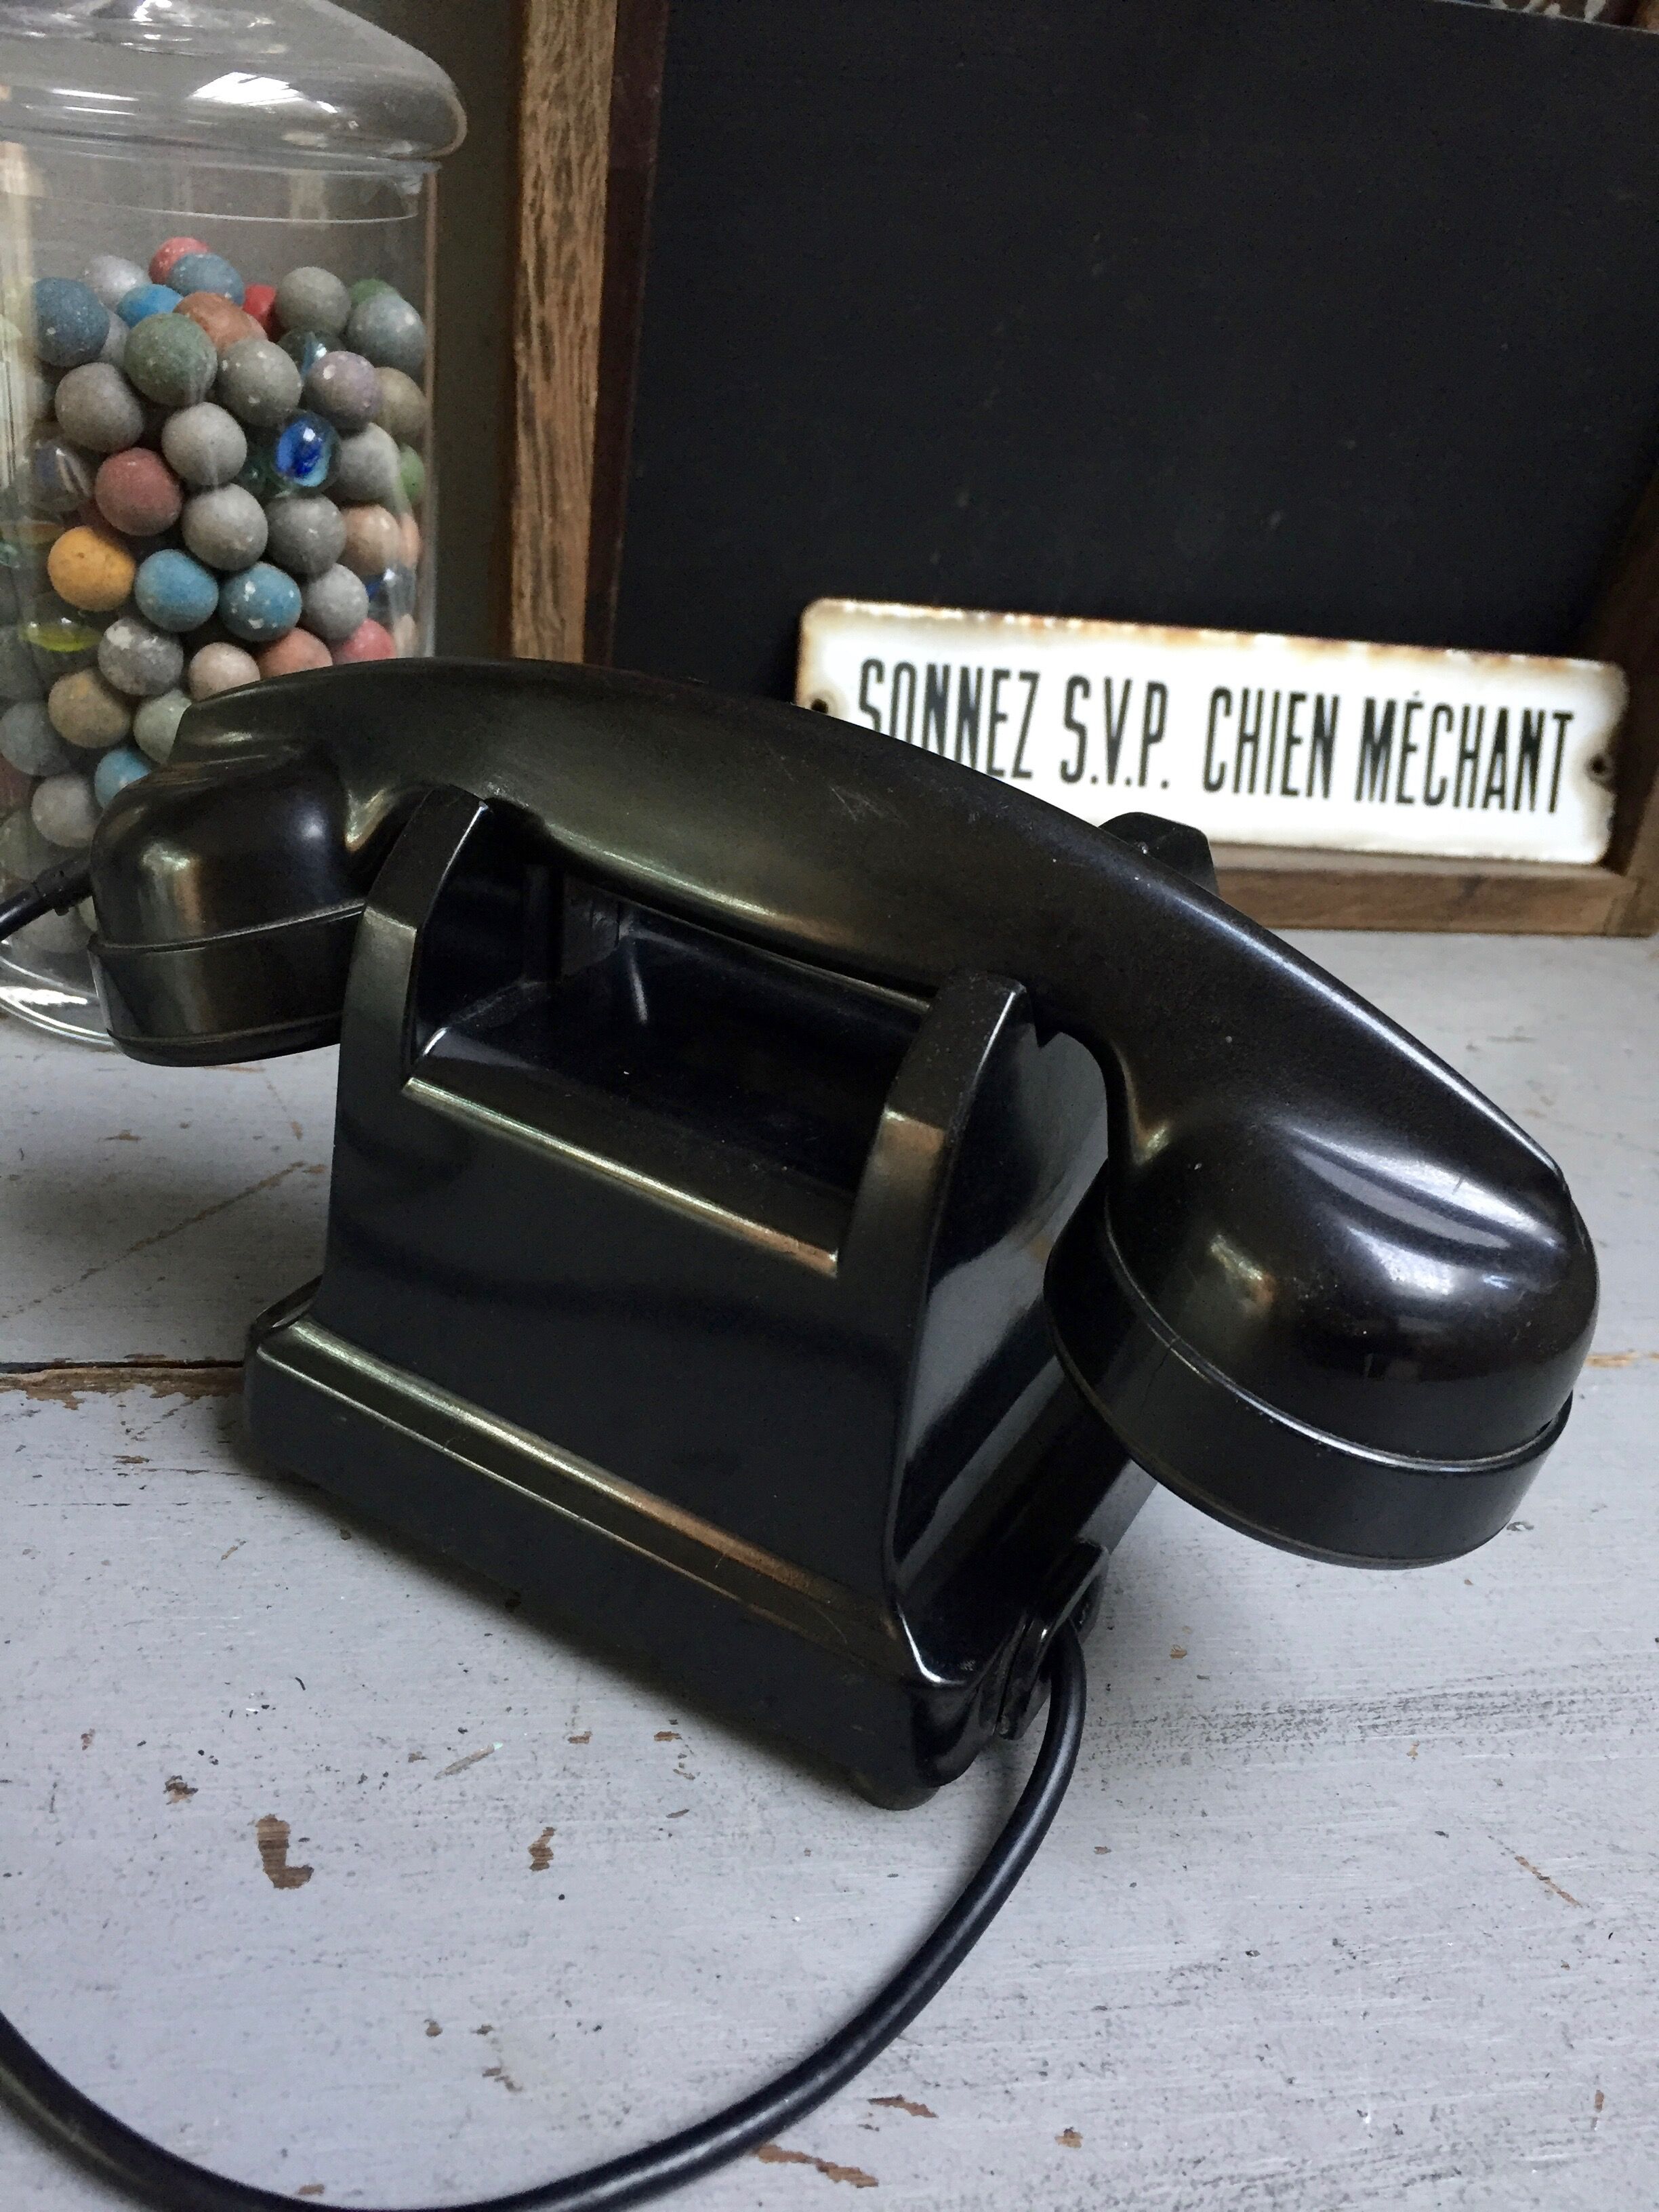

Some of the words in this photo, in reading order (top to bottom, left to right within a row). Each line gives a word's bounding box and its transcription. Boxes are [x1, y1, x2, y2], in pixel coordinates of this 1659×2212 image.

[859, 658, 1040, 779] SONNEZ
[1060, 675, 1170, 790] S.V.P.
[1203, 686, 1340, 799] CHIEN
[1356, 691, 1574, 814] MÉCHANT
